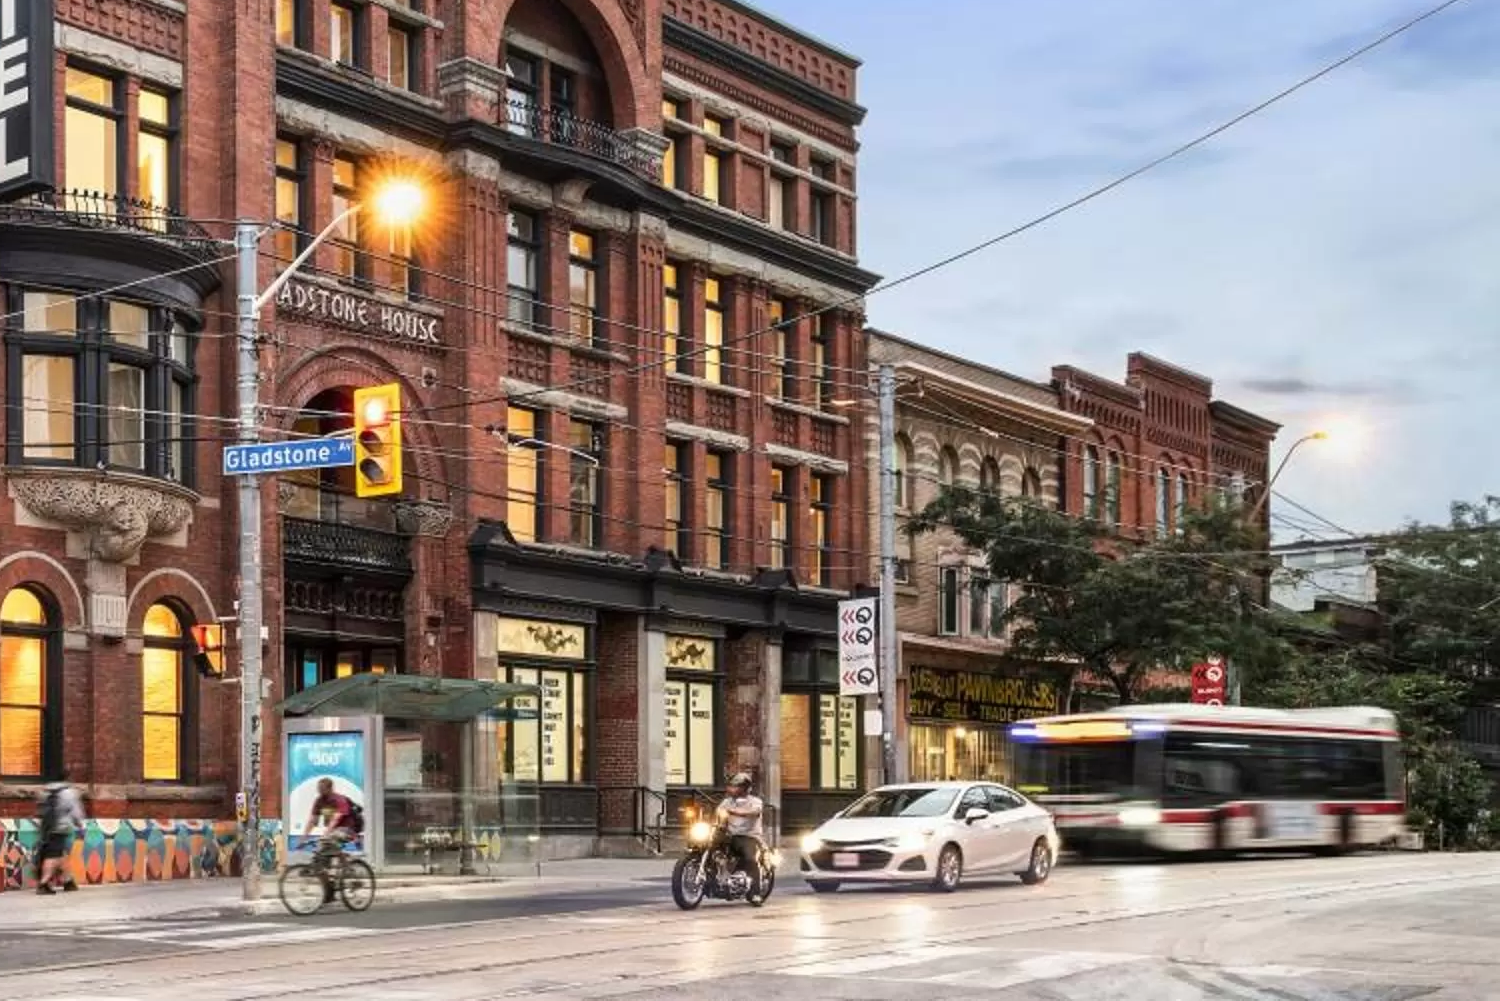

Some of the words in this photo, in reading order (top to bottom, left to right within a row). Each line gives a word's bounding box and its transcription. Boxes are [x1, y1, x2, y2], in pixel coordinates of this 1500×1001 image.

[381, 306, 439, 343] HOUSE
[227, 446, 330, 469] Gladstone
[909, 698, 934, 716] BUY
[943, 702, 968, 719] SELL
[980, 704, 1015, 721] TRADE
